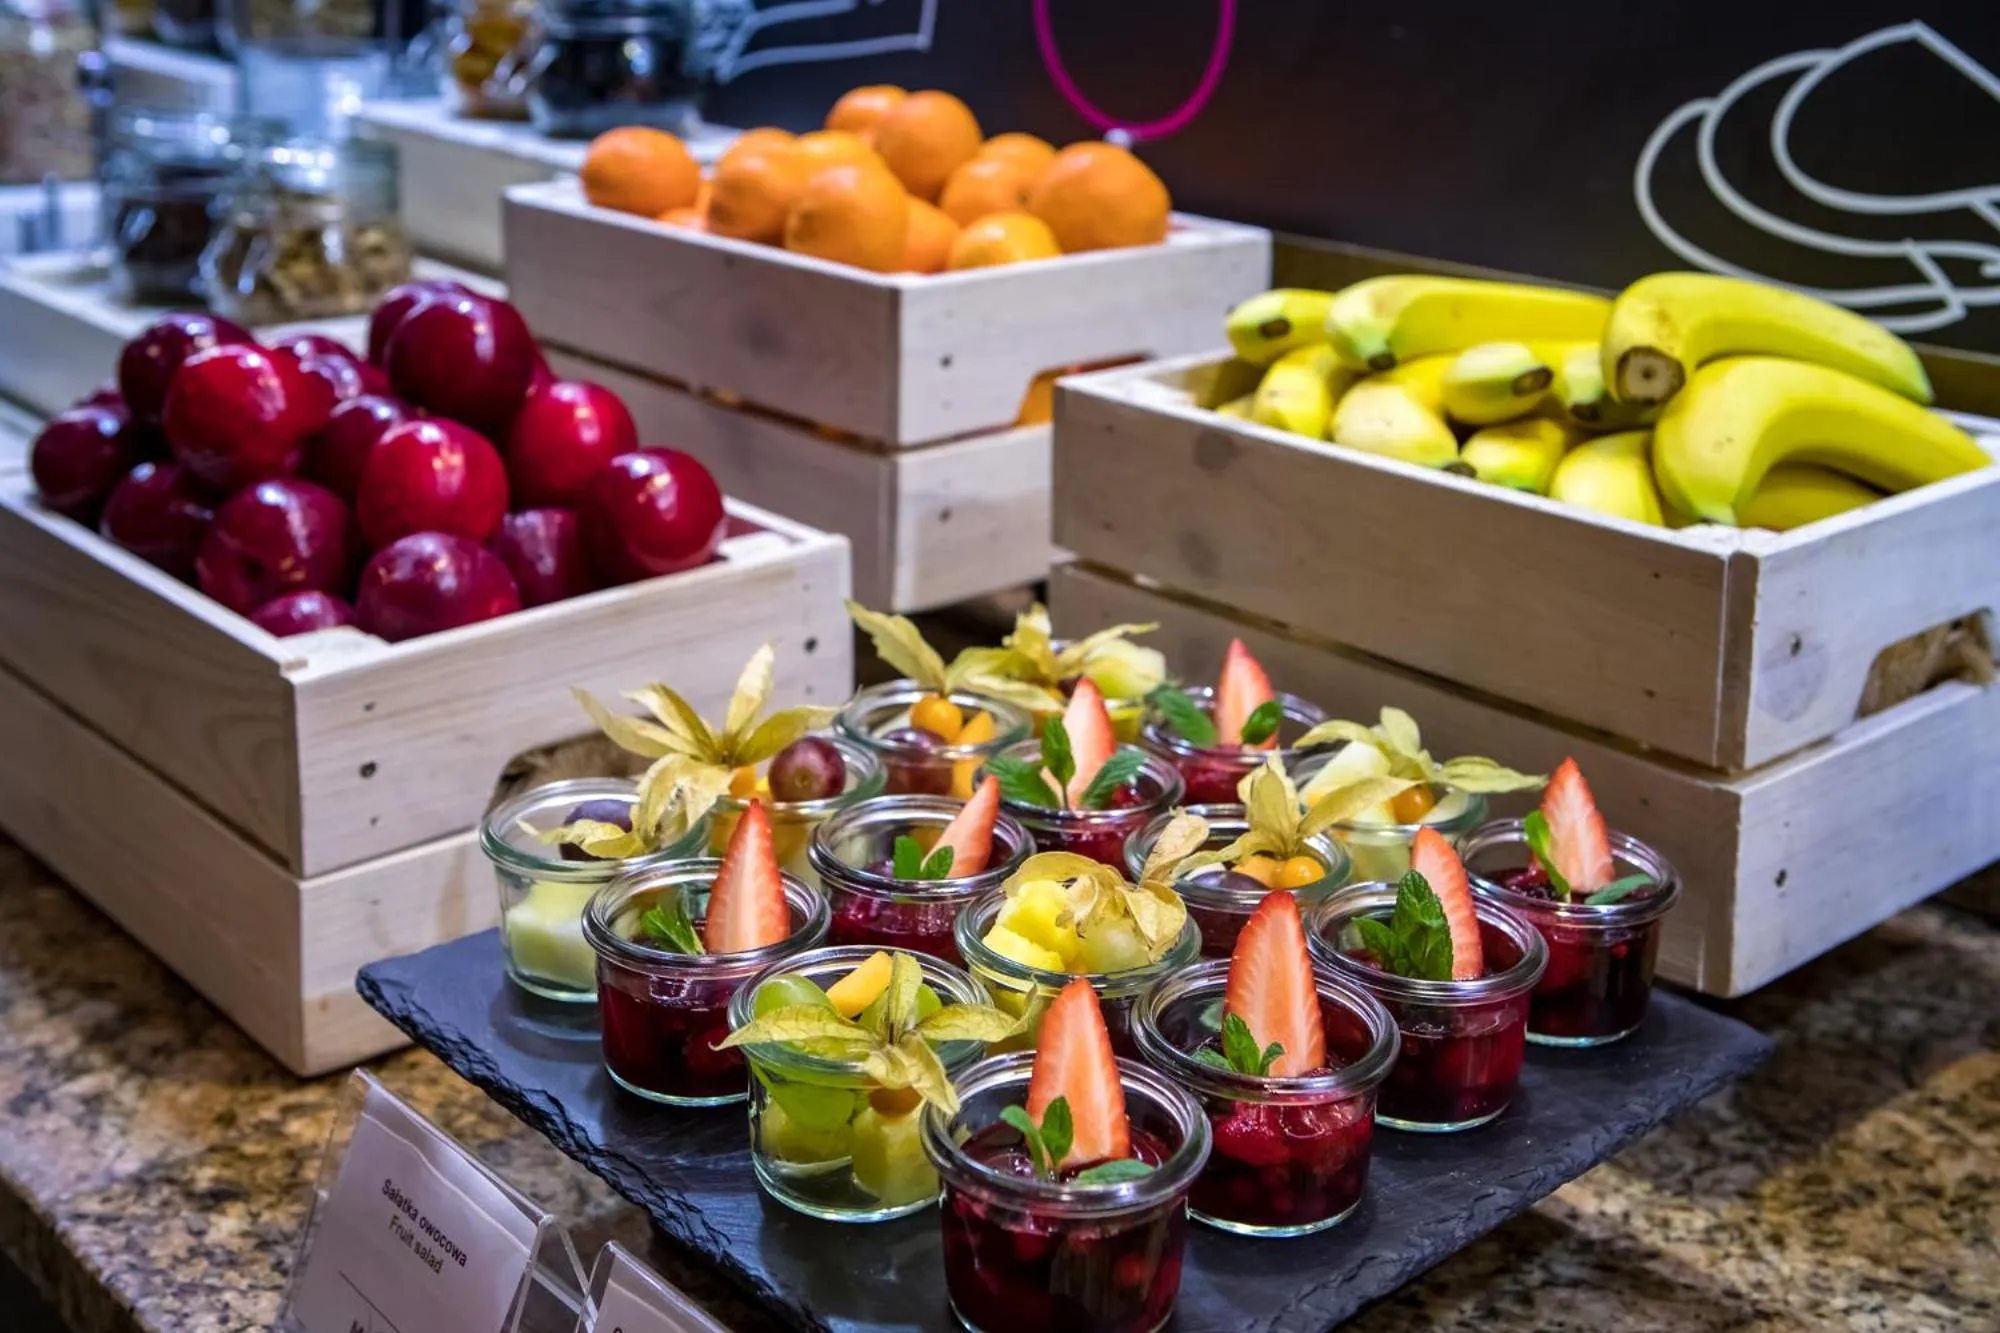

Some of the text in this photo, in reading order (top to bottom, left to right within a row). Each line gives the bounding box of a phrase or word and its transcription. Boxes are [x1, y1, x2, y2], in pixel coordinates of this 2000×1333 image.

[388, 1213, 444, 1274] Fruit salad
[419, 1216, 467, 1268] owocowa
